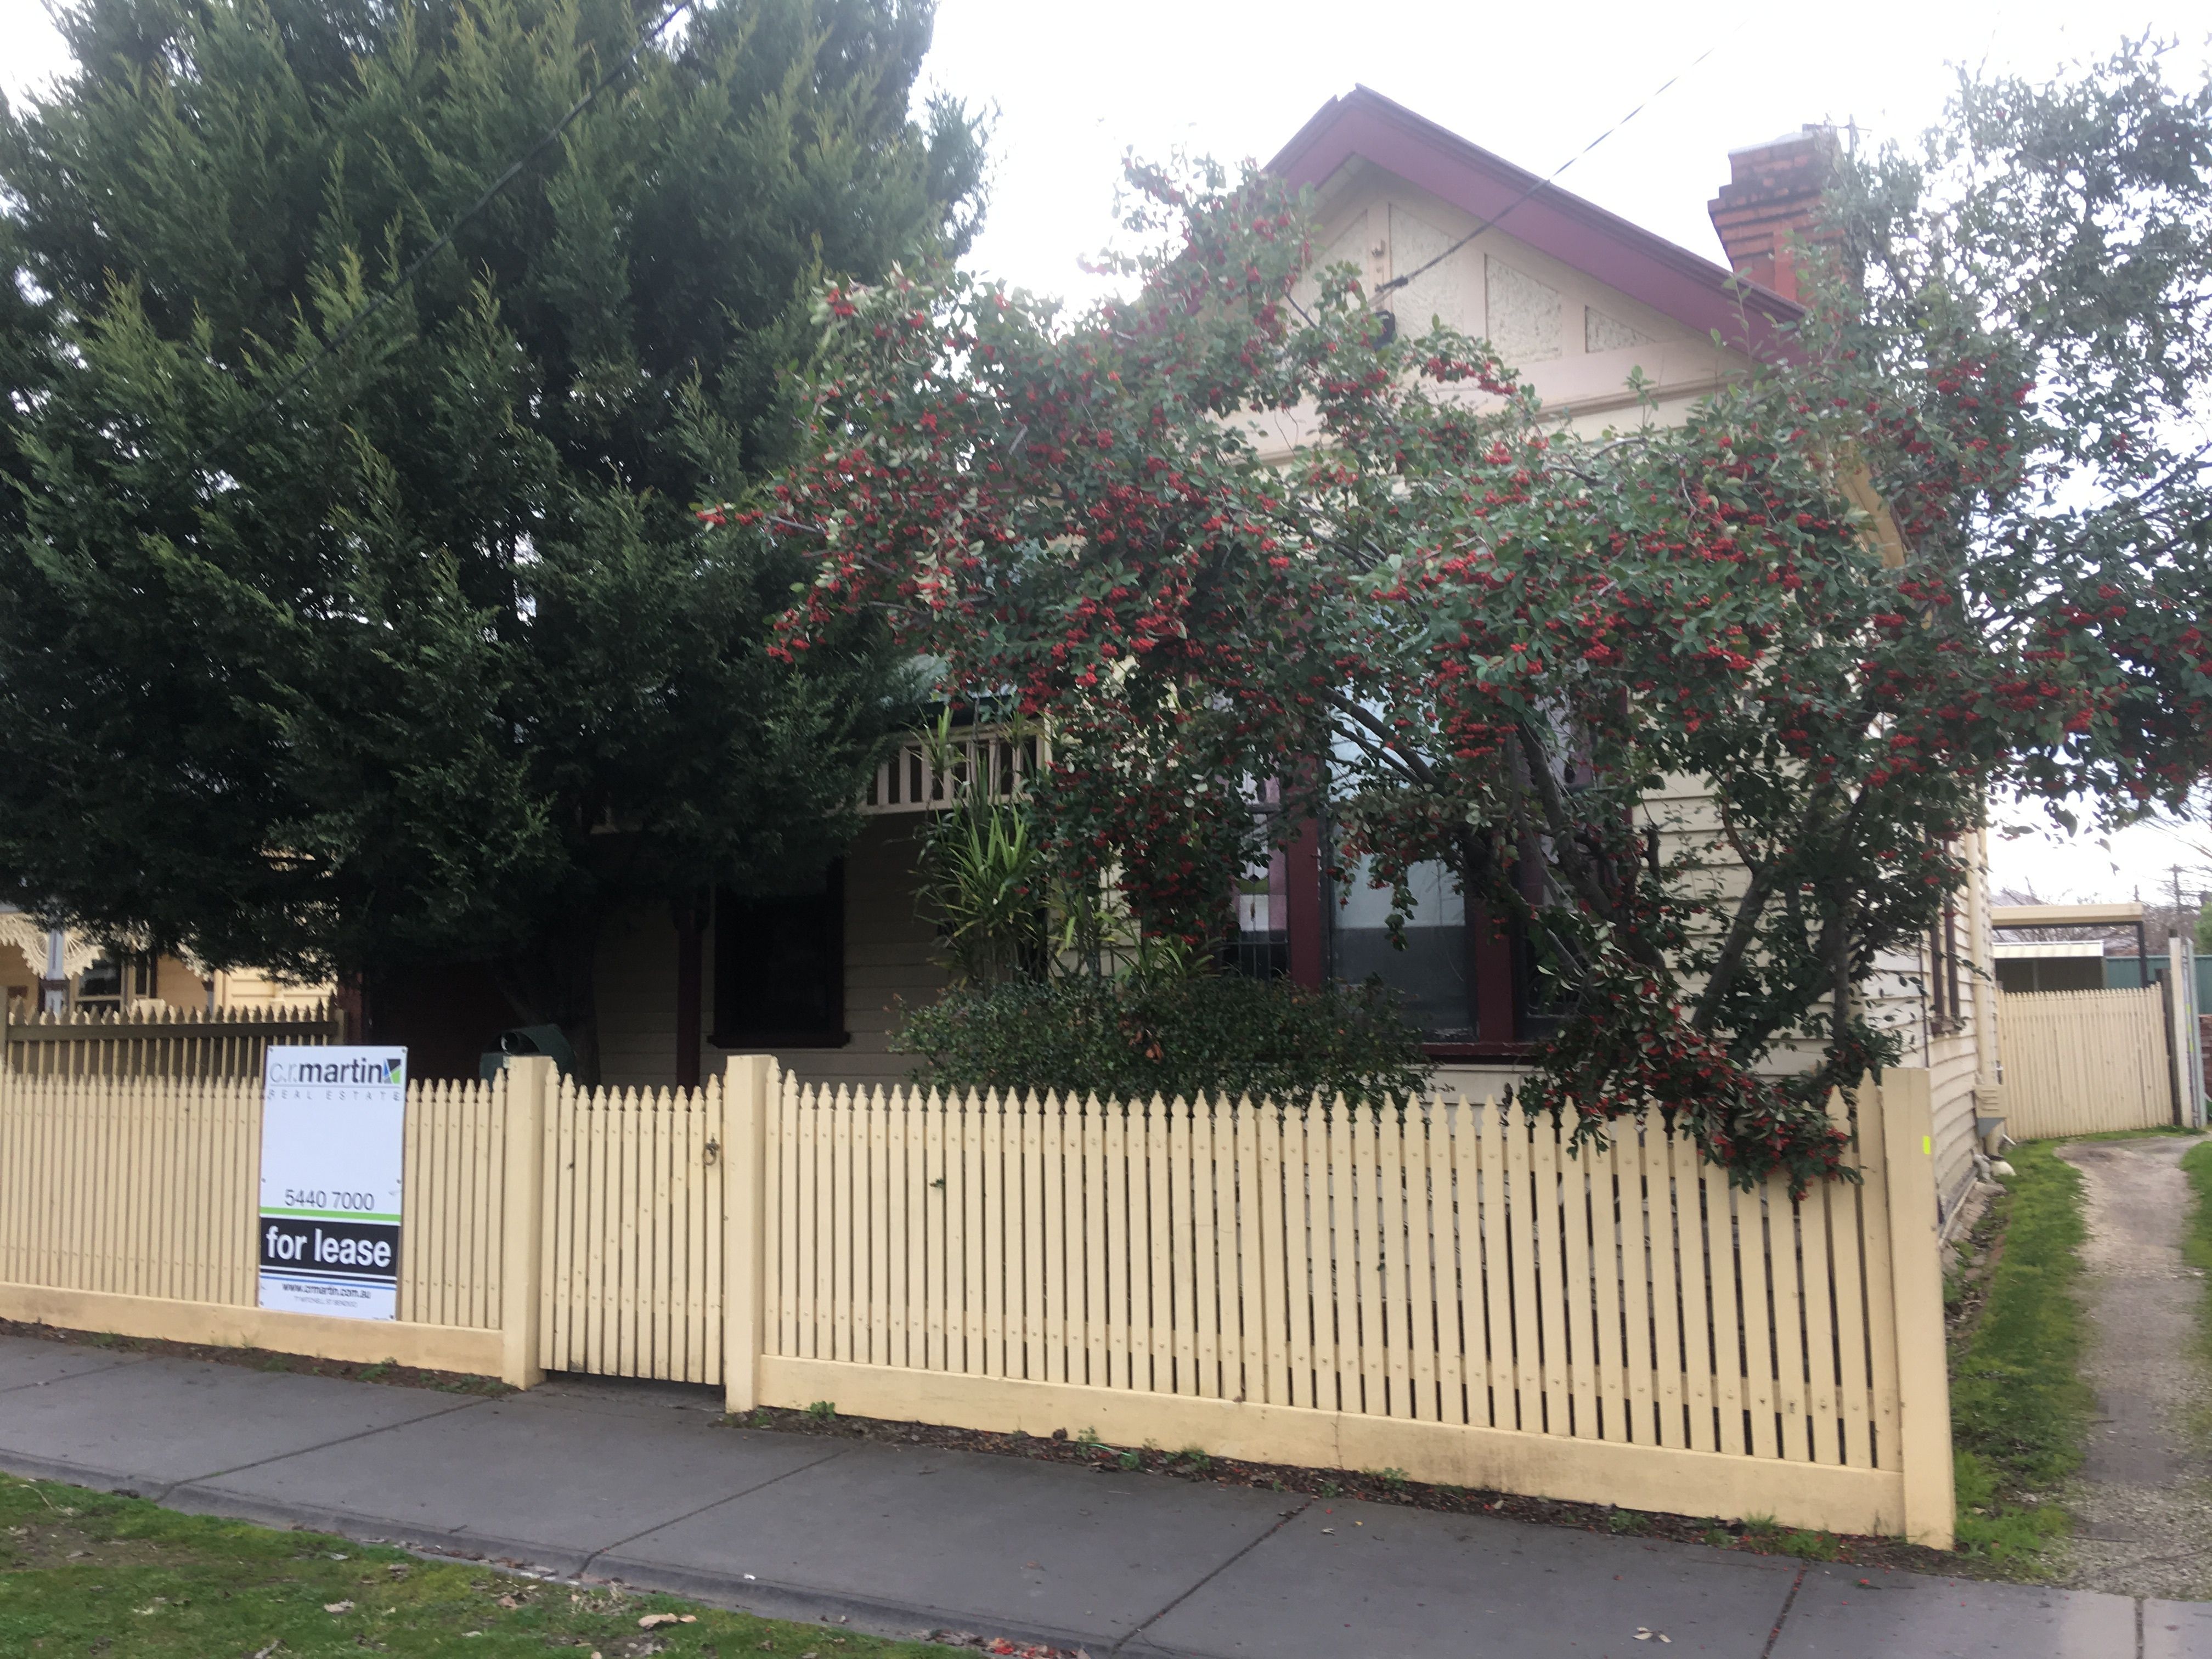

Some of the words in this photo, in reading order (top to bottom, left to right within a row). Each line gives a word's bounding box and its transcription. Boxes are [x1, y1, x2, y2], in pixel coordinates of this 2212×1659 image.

[268, 1089, 313, 1100] REAL
[326, 1090, 400, 1102] ESTATE
[285, 1189, 327, 1208] 5440
[332, 1192, 375, 1211] 7000
[266, 1226, 308, 1260] for
[314, 1228, 392, 1268] lease
